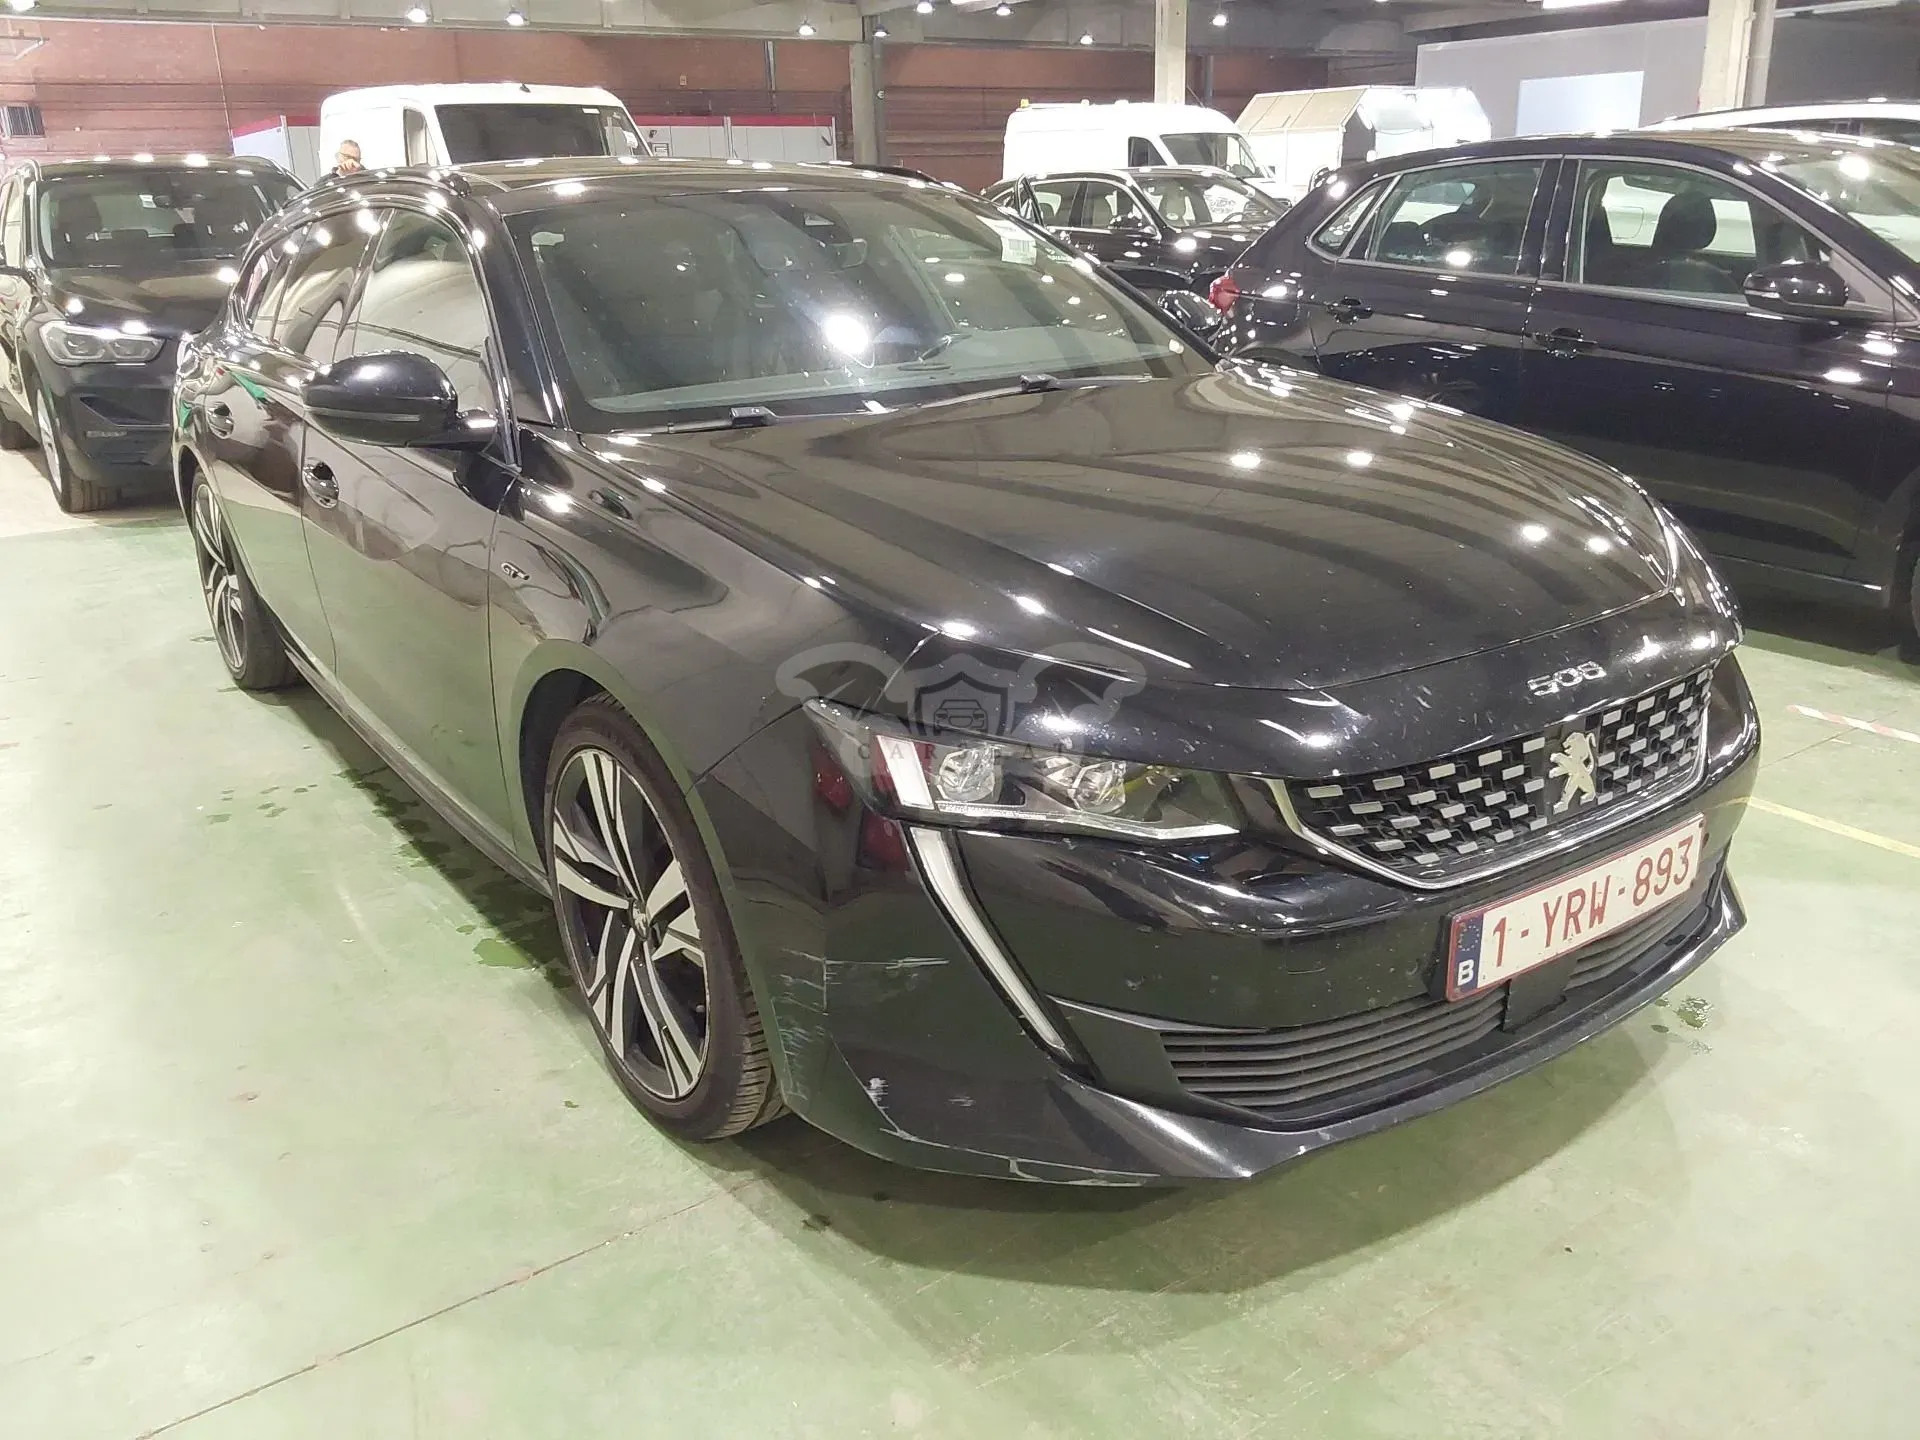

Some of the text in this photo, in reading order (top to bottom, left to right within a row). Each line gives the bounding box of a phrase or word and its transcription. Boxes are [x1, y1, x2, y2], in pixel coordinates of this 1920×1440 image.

[1527, 661, 1607, 696] 508
[1493, 836, 1694, 967] 1-YRW-893
[1457, 959, 1474, 986] B
